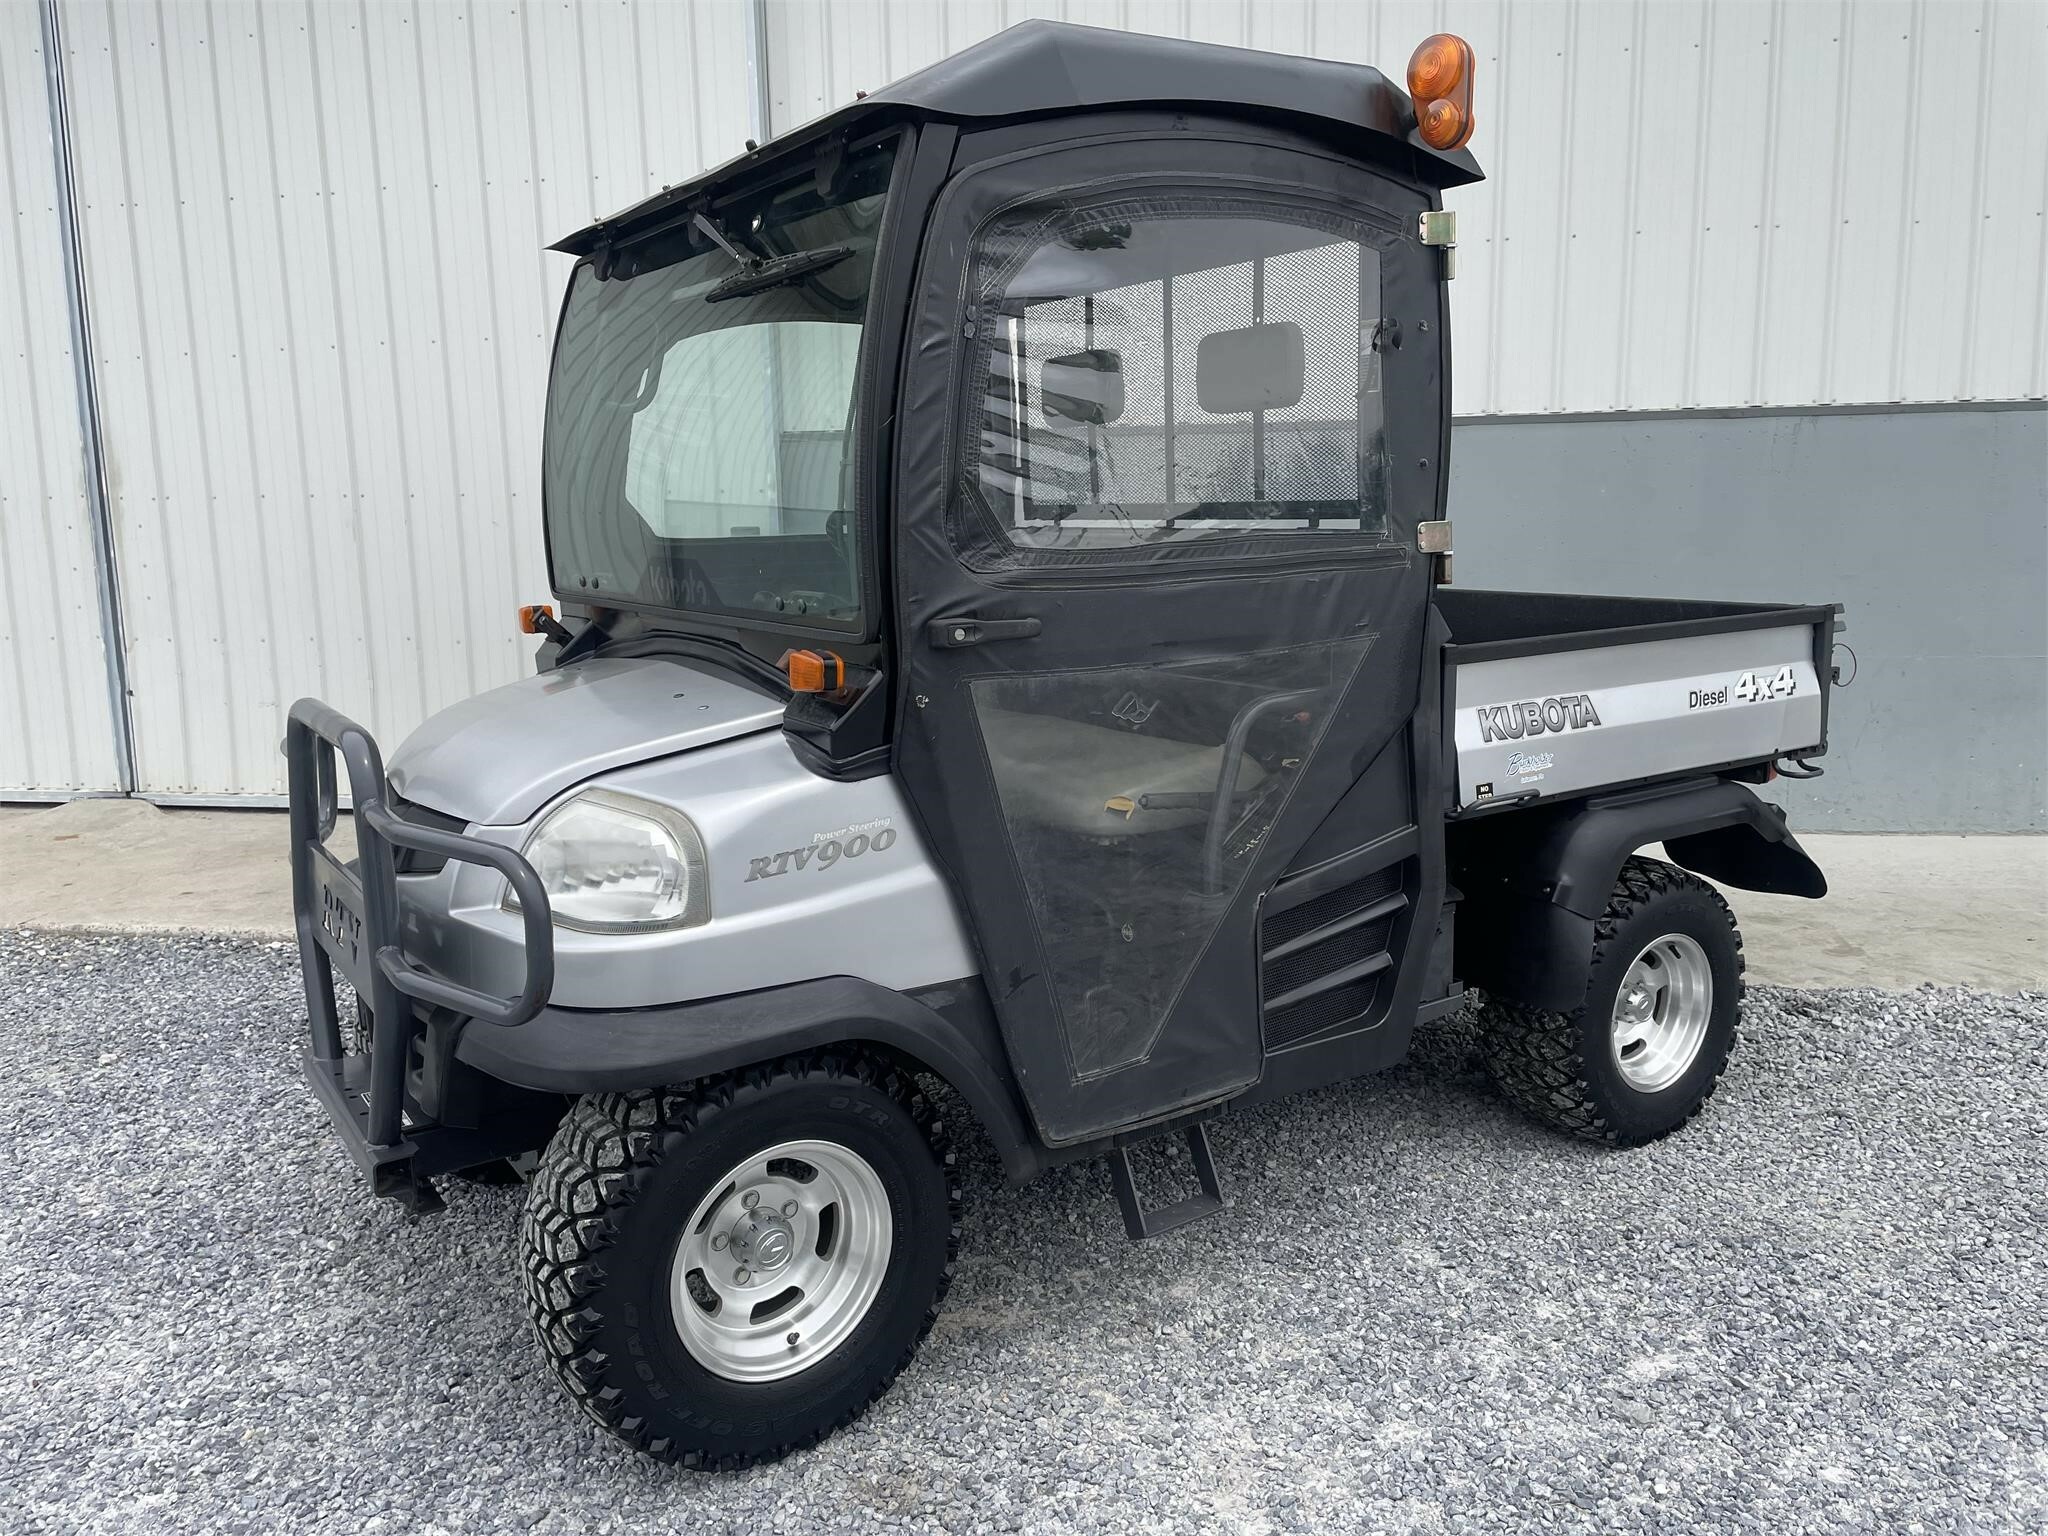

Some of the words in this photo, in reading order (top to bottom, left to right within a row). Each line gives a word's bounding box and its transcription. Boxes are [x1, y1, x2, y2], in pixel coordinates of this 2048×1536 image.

[1689, 686, 1728, 709] Diesel
[1734, 665, 1796, 702] 4x4
[1478, 694, 1601, 744] KUBOTA
[1480, 785, 1489, 793] NO
[812, 828, 847, 843] Power
[848, 816, 891, 834] Steering
[744, 828, 897, 883] RTV900
[322, 884, 362, 967] RTV
